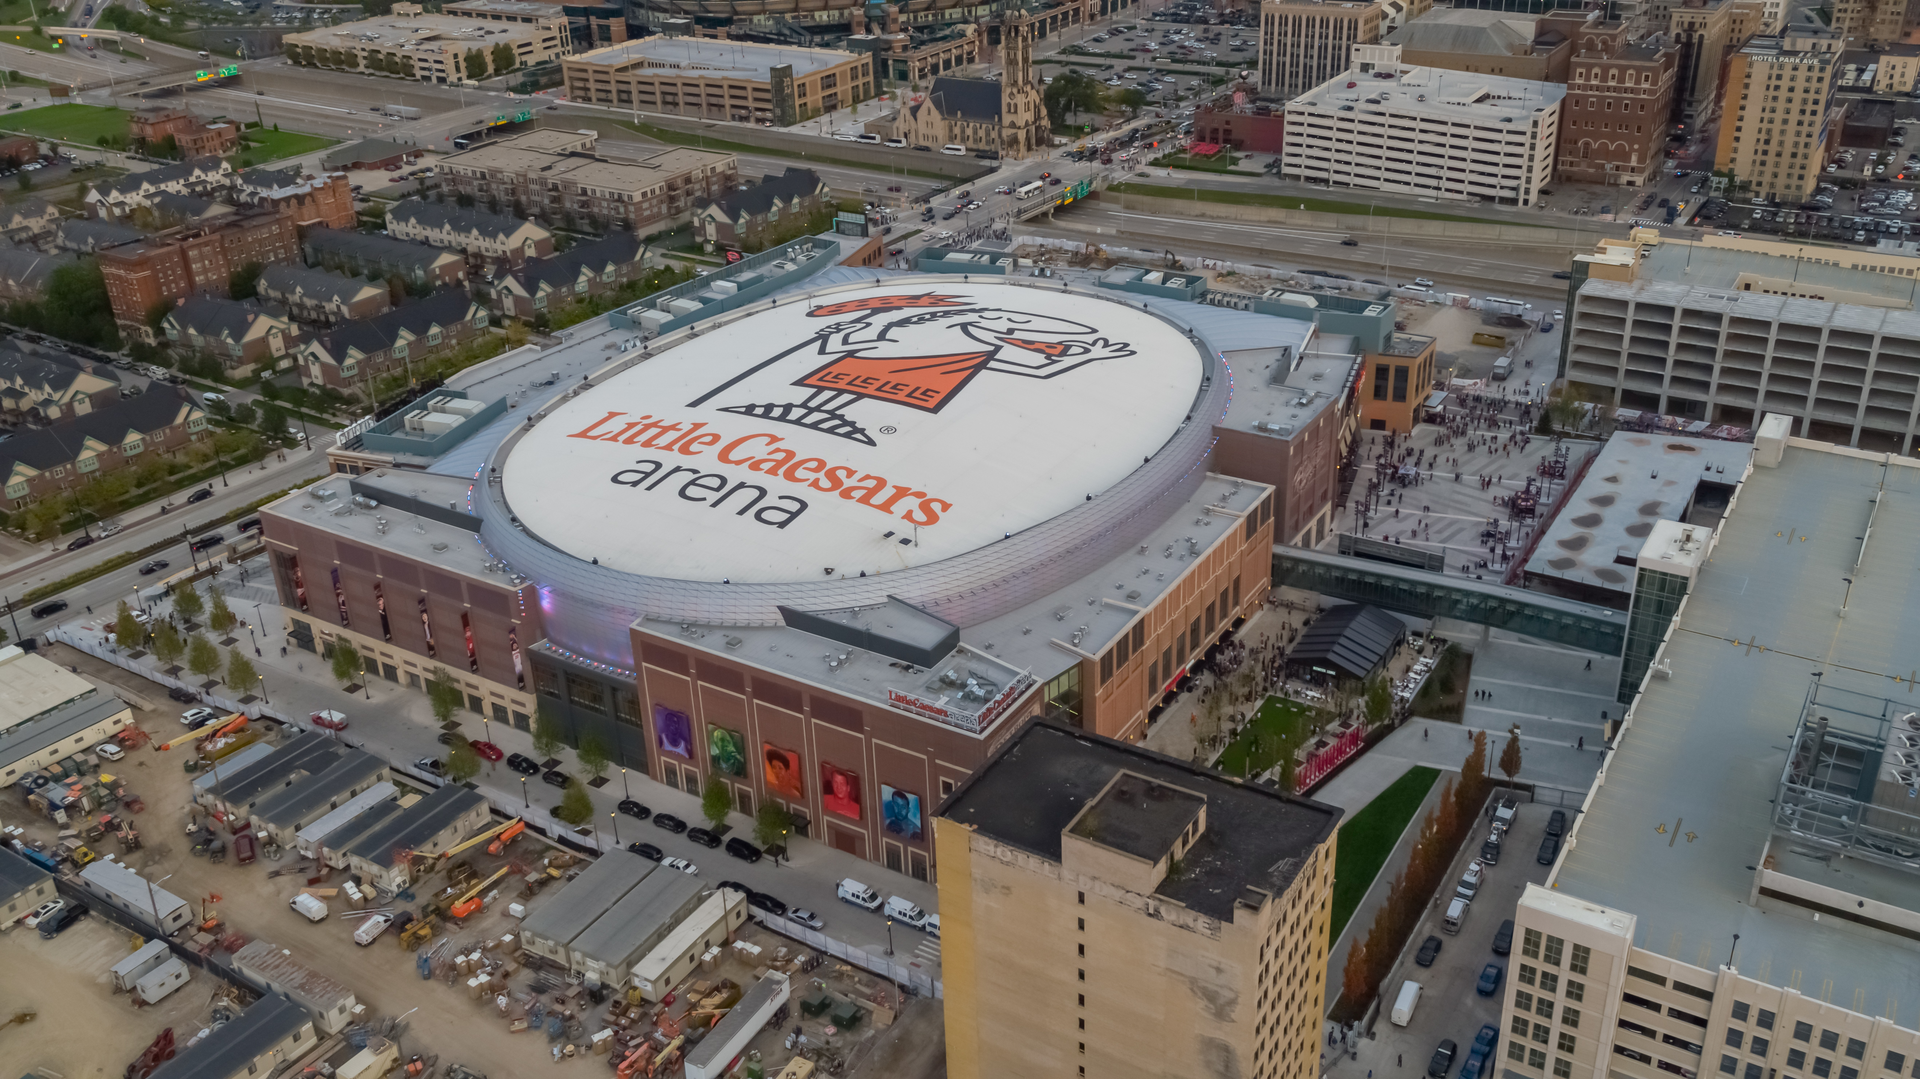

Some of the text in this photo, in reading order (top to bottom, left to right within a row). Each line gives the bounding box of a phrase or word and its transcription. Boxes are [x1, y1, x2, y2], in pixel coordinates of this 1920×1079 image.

[566, 411, 953, 527] Little Caesars
[610, 459, 809, 530] arena
[978, 837, 1061, 880] HOTEL
